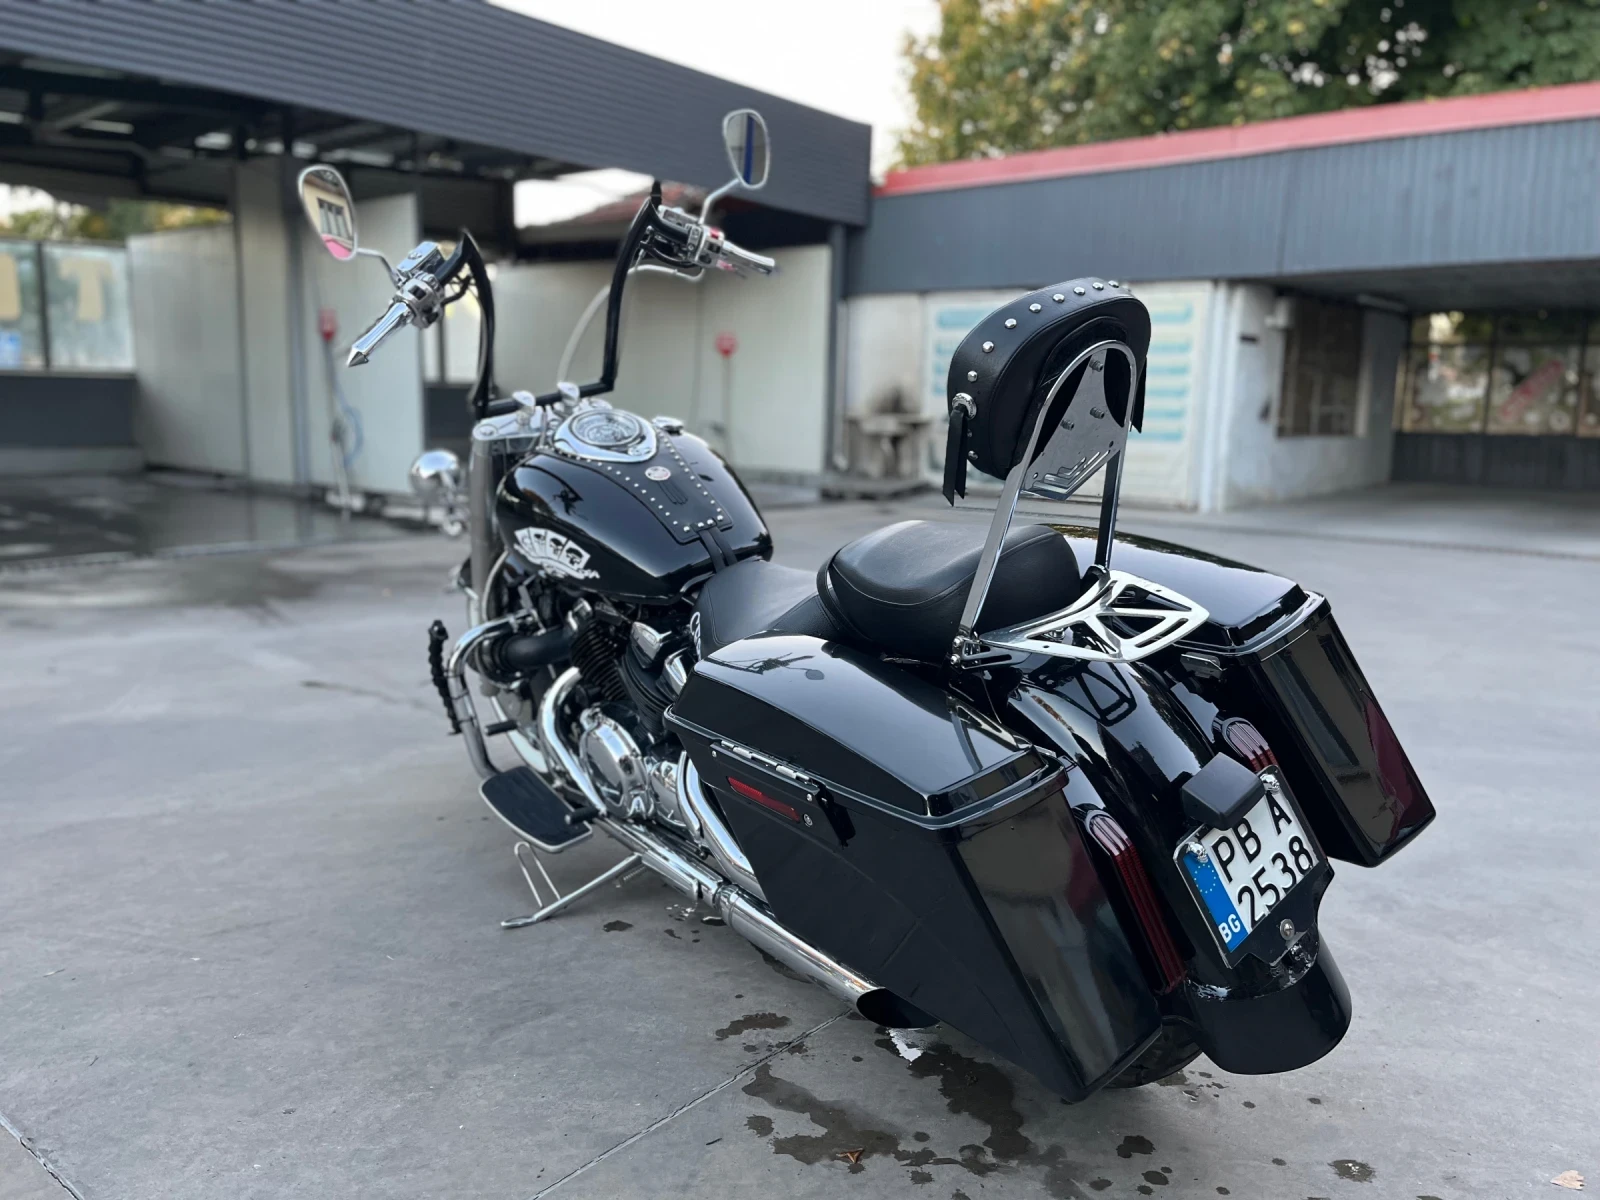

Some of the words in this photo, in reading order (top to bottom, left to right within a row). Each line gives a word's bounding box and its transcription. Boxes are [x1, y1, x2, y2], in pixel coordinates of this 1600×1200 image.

[1211, 817, 1262, 883] PB
[1266, 790, 1292, 836] A
[1237, 835, 1313, 928] 2538
[1218, 913, 1242, 943] BG
